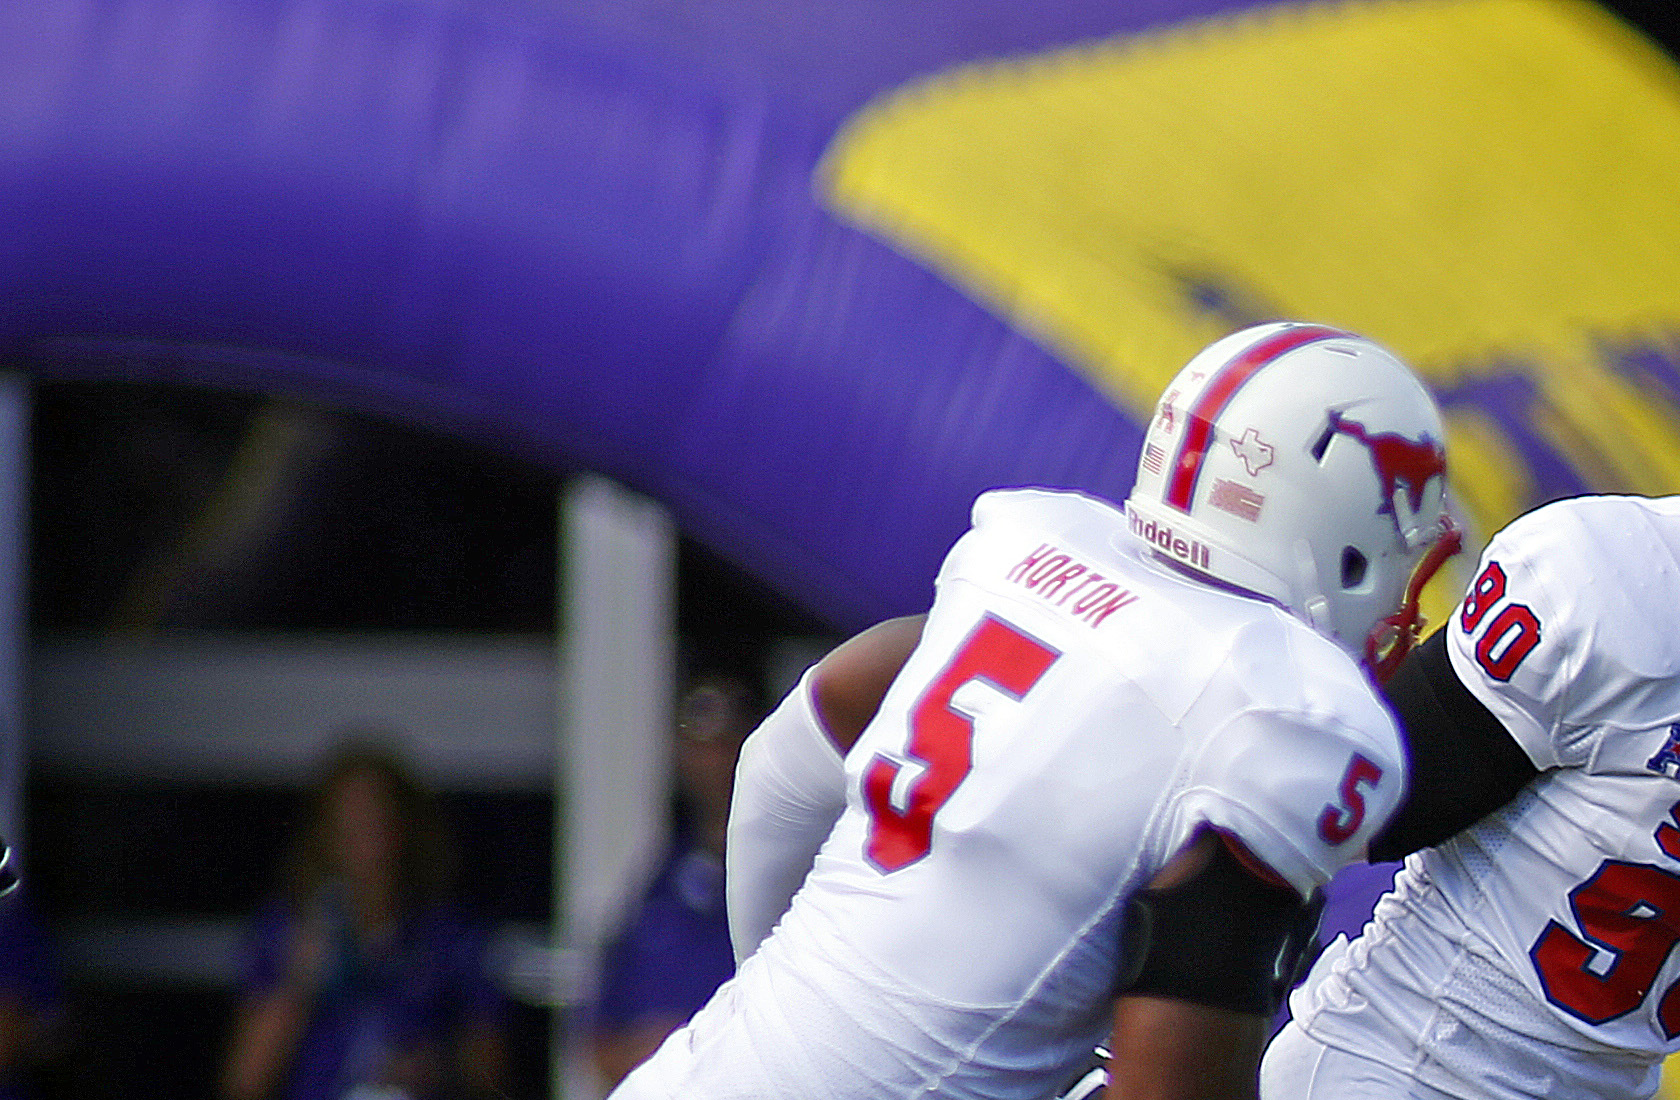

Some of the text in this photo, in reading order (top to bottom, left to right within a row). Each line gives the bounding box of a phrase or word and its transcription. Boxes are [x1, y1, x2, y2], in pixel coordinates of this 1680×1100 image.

[1004, 542, 1141, 630] HORTON
[860, 609, 1065, 878] 5
[1315, 750, 1385, 848] 5
